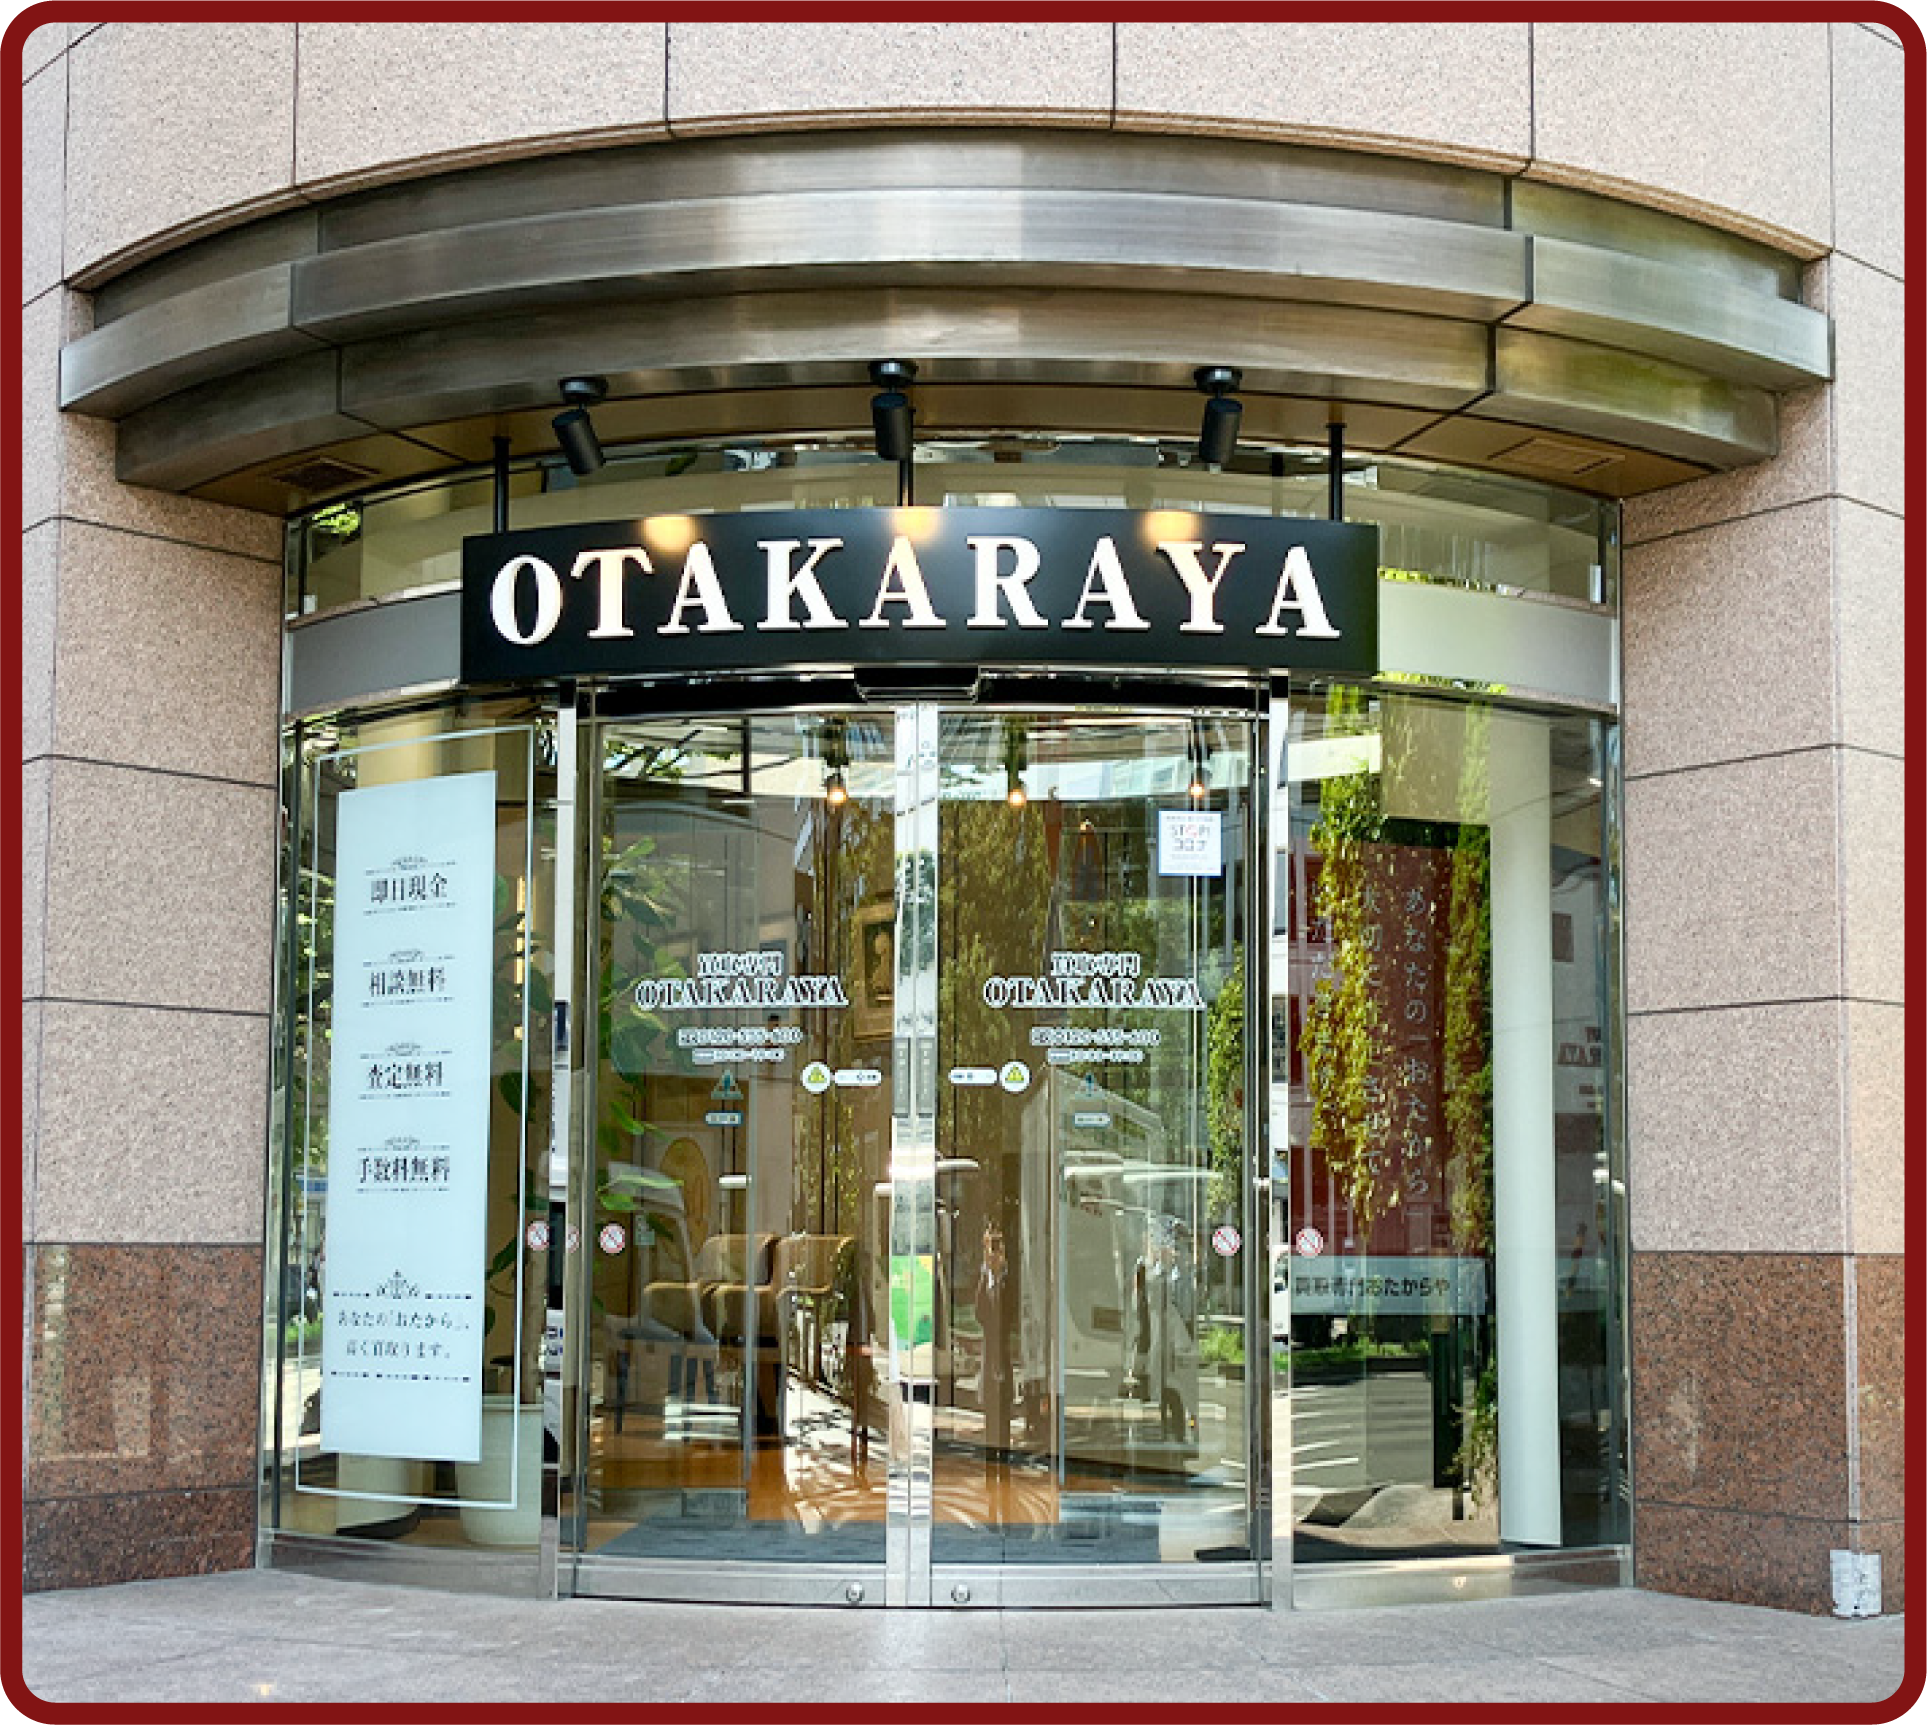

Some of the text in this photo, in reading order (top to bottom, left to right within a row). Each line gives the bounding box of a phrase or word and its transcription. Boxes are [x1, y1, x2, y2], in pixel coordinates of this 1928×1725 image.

[489, 535, 1341, 646] OTAKARAYA
[370, 872, 448, 905] 即日現金
[369, 966, 447, 997] 相談無料
[635, 975, 849, 1010] OTAKARAYA
[983, 975, 1207, 1010] OTAKARAYA
[367, 1061, 443, 1090] 査定無料
[359, 1154, 450, 1184] 手数料無料
